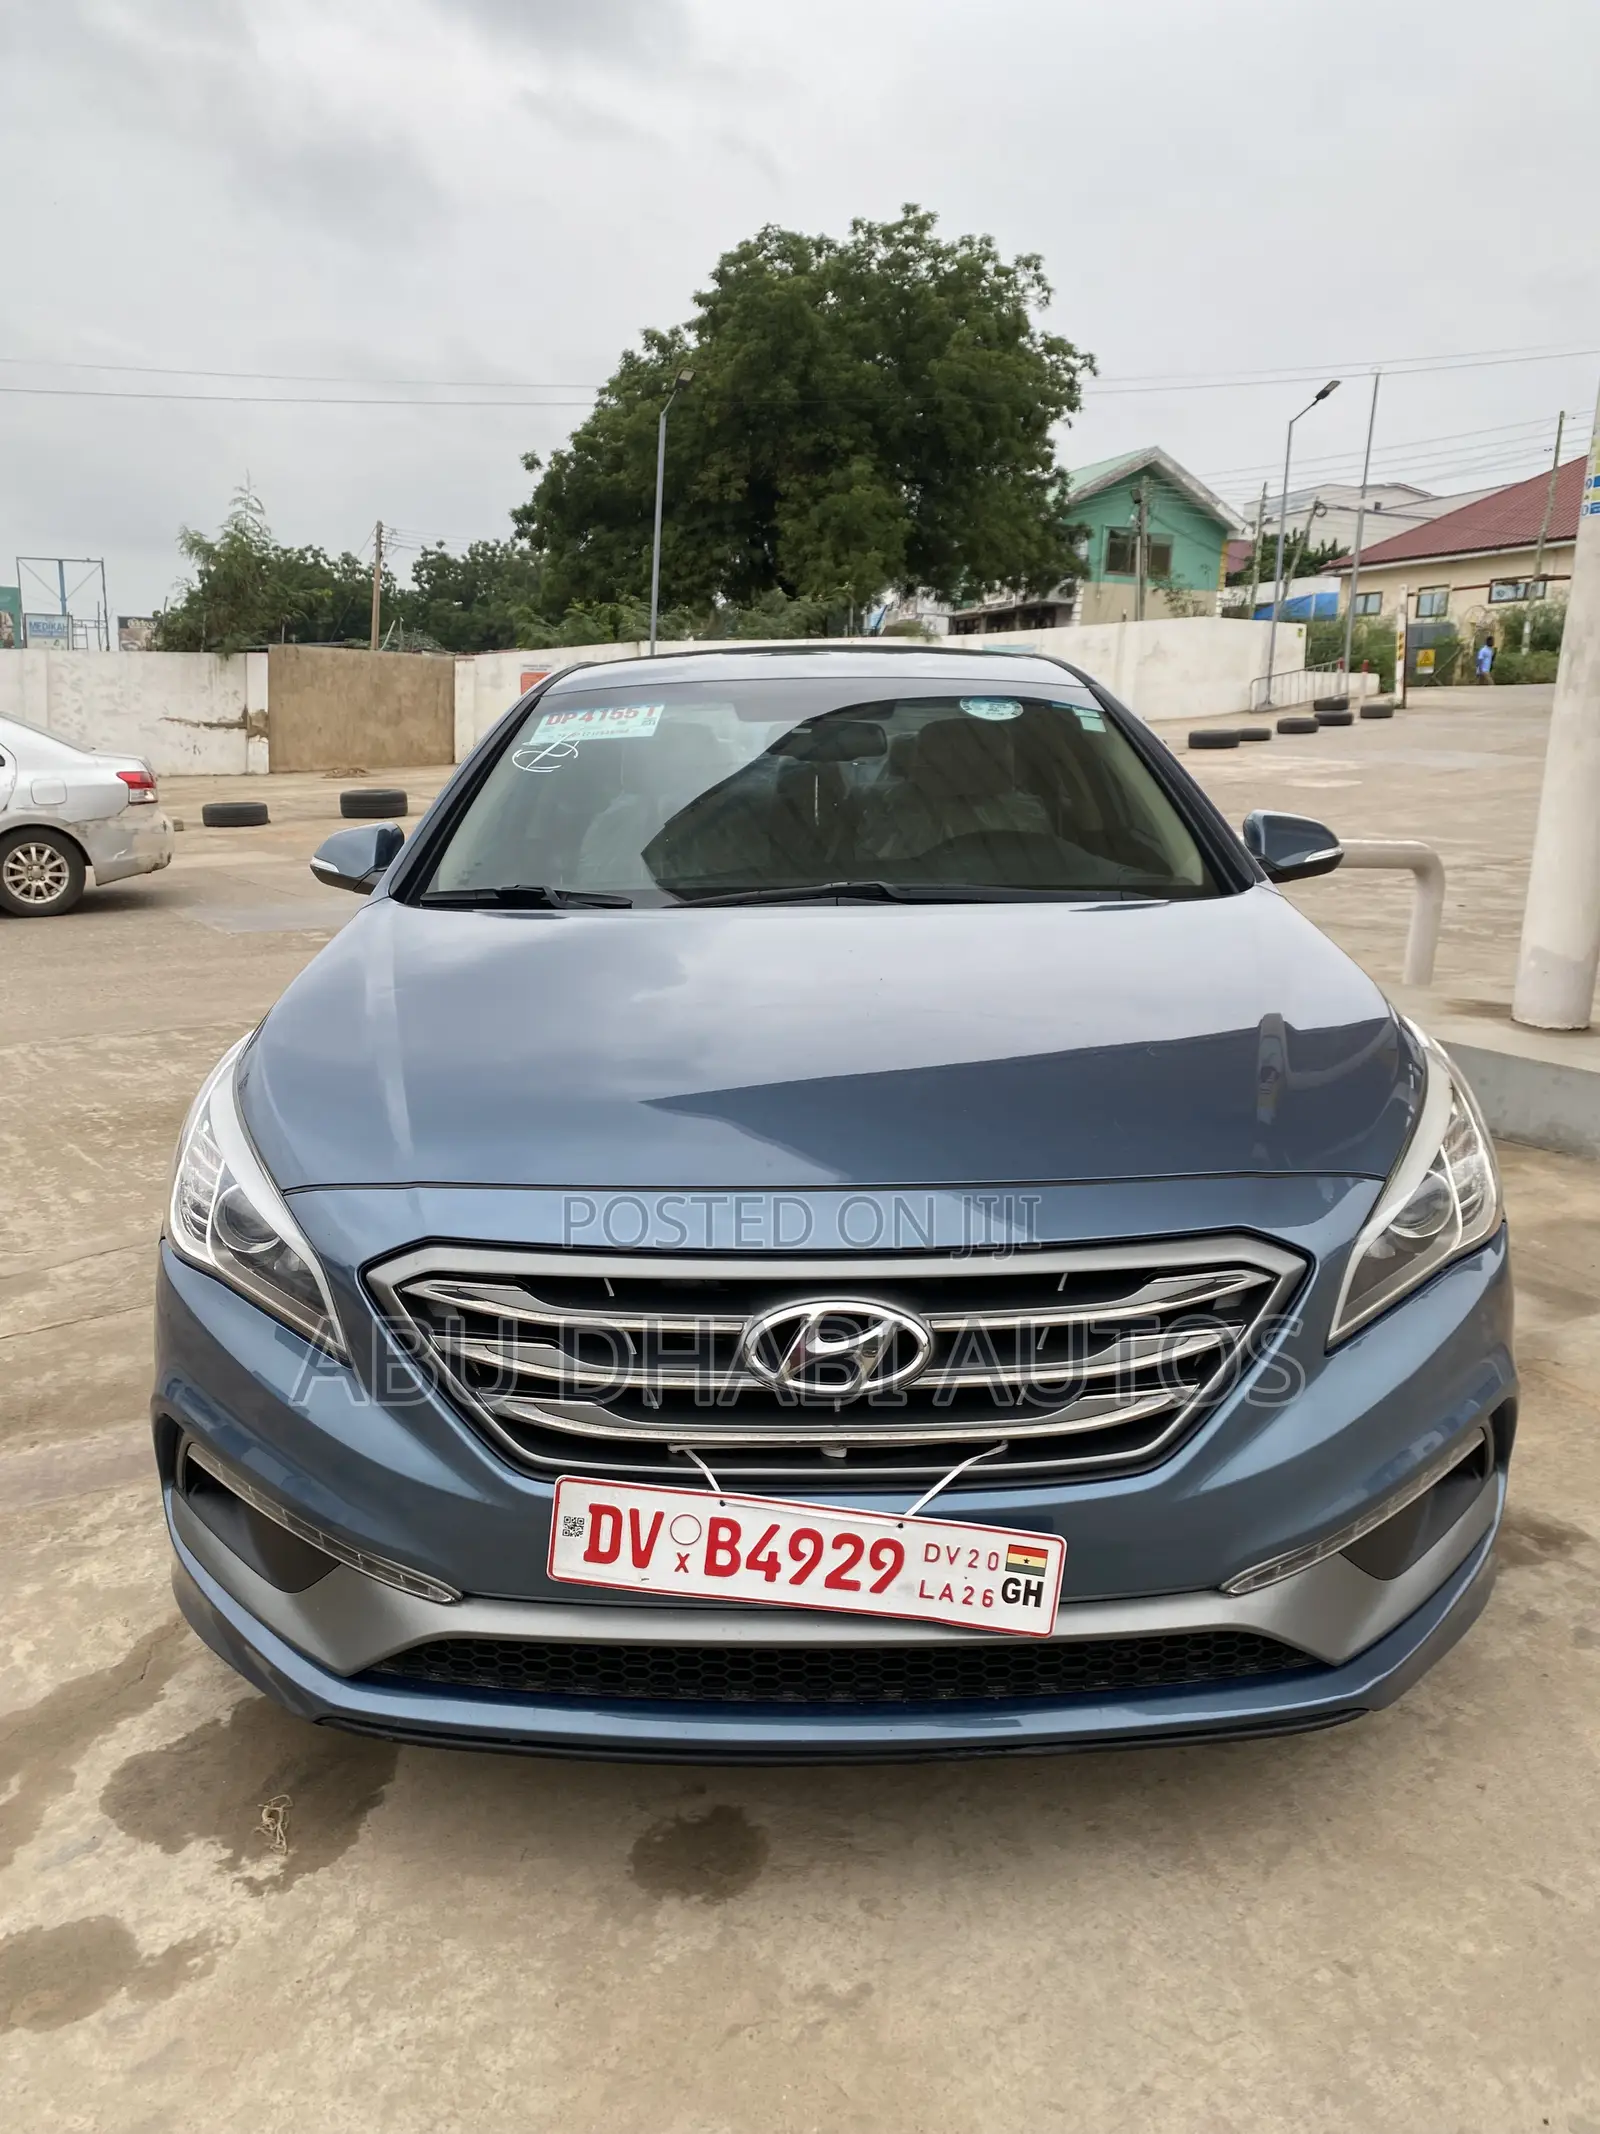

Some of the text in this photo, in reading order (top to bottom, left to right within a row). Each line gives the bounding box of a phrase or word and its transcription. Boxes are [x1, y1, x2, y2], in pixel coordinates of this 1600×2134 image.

[583, 1502, 665, 1569] DV
[703, 1516, 905, 1594] B4929
[924, 1542, 1000, 1572] DV20
[918, 1579, 995, 1608] LA26
[1001, 1577, 1045, 1609] GH
